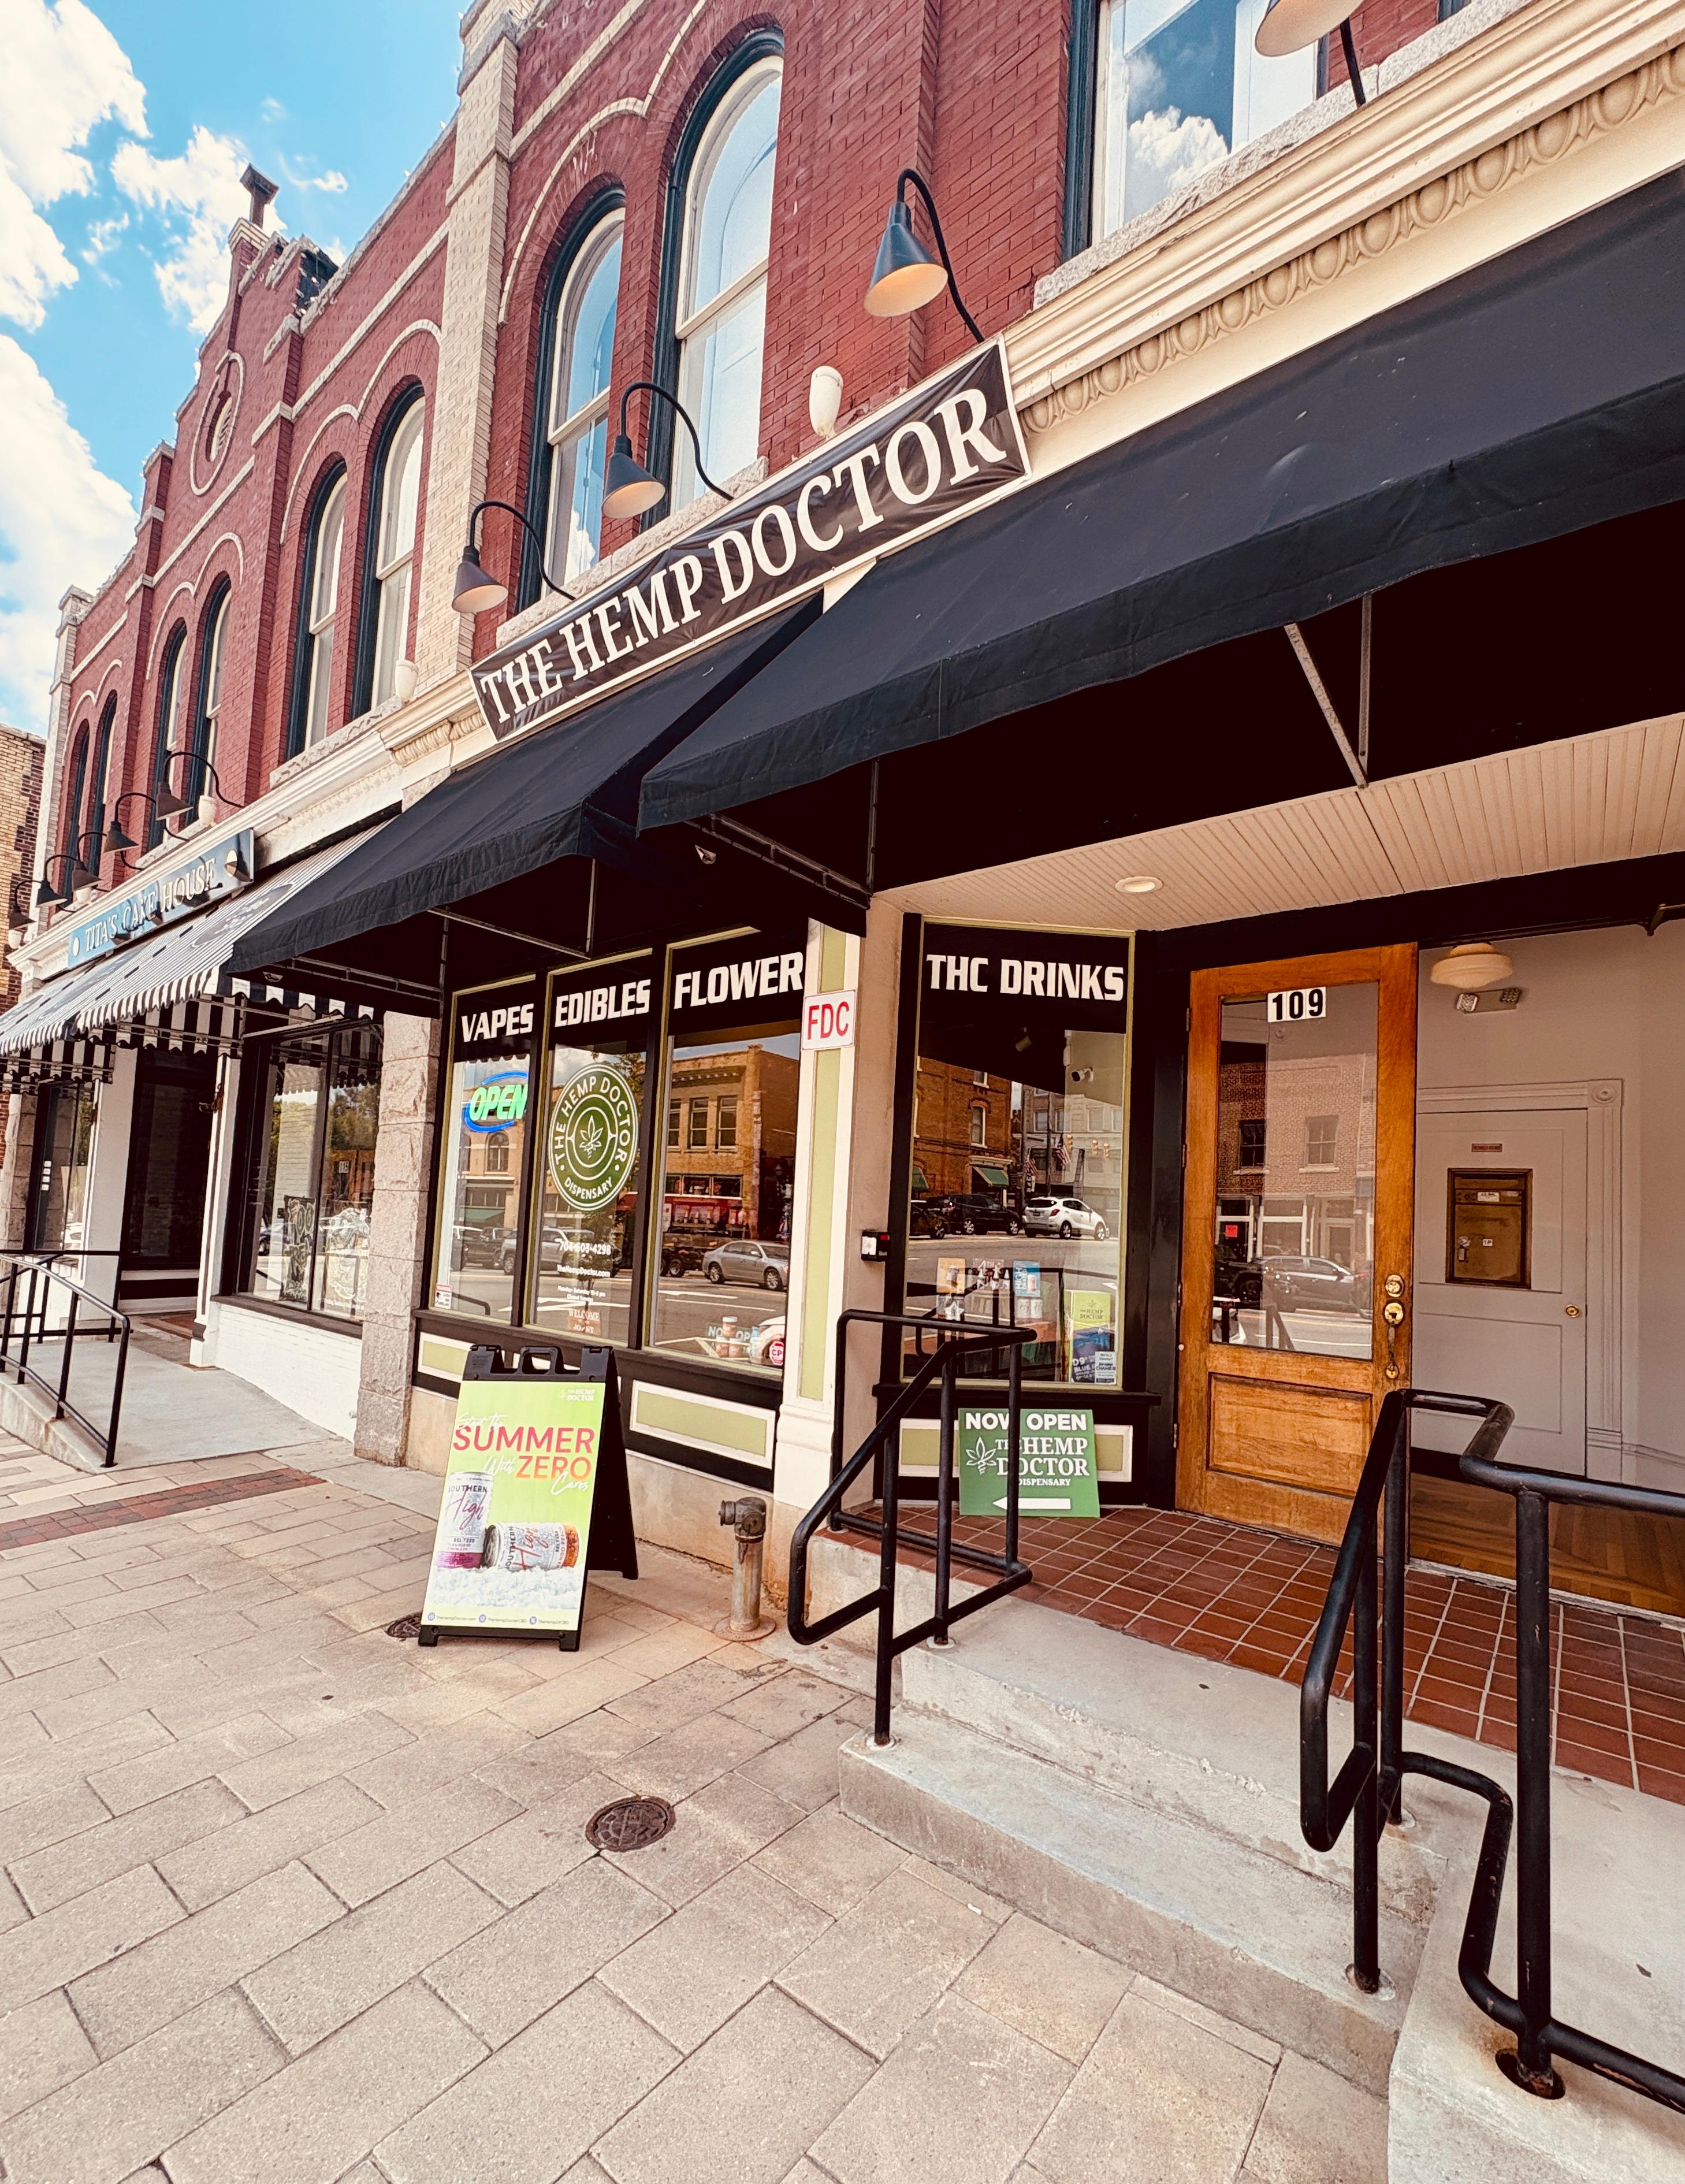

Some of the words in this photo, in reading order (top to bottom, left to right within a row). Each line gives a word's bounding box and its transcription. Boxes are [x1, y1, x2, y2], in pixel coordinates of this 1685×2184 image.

[481, 638, 564, 723] THE
[559, 554, 702, 682] HEMP
[709, 388, 1007, 604] DOCTOR
[85, 913, 118, 951] TITA'S
[122, 890, 157, 931] CAKE
[161, 857, 216, 912] HOUSE
[674, 952, 804, 1009] FLOWER
[927, 954, 988, 993] THC
[1000, 959, 1125, 1001] DRINKS
[554, 979, 651, 1027] EDIBLES
[1272, 988, 1323, 1020] 109
[462, 1004, 534, 1042] VAPES
[807, 1002, 849, 1039] FDC
[469, 1084, 528, 1121] OPEN
[554, 1123, 567, 1165] THE
[561, 1076, 597, 1117] HEMP
[600, 1077, 631, 1162] DOCTOR
[564, 1176, 612, 1199] DISPENSARY
[568, 1308, 600, 1321] WELCOME
[708, 1326, 722, 1336] NO
[453, 1425, 595, 1453] SUMMER
[1026, 1413, 1087, 1431] OPEN
[1022, 1437, 1088, 1455] HEMP
[516, 1455, 592, 1480] ZERO
[996, 1458, 1090, 1476] DOCTOR
